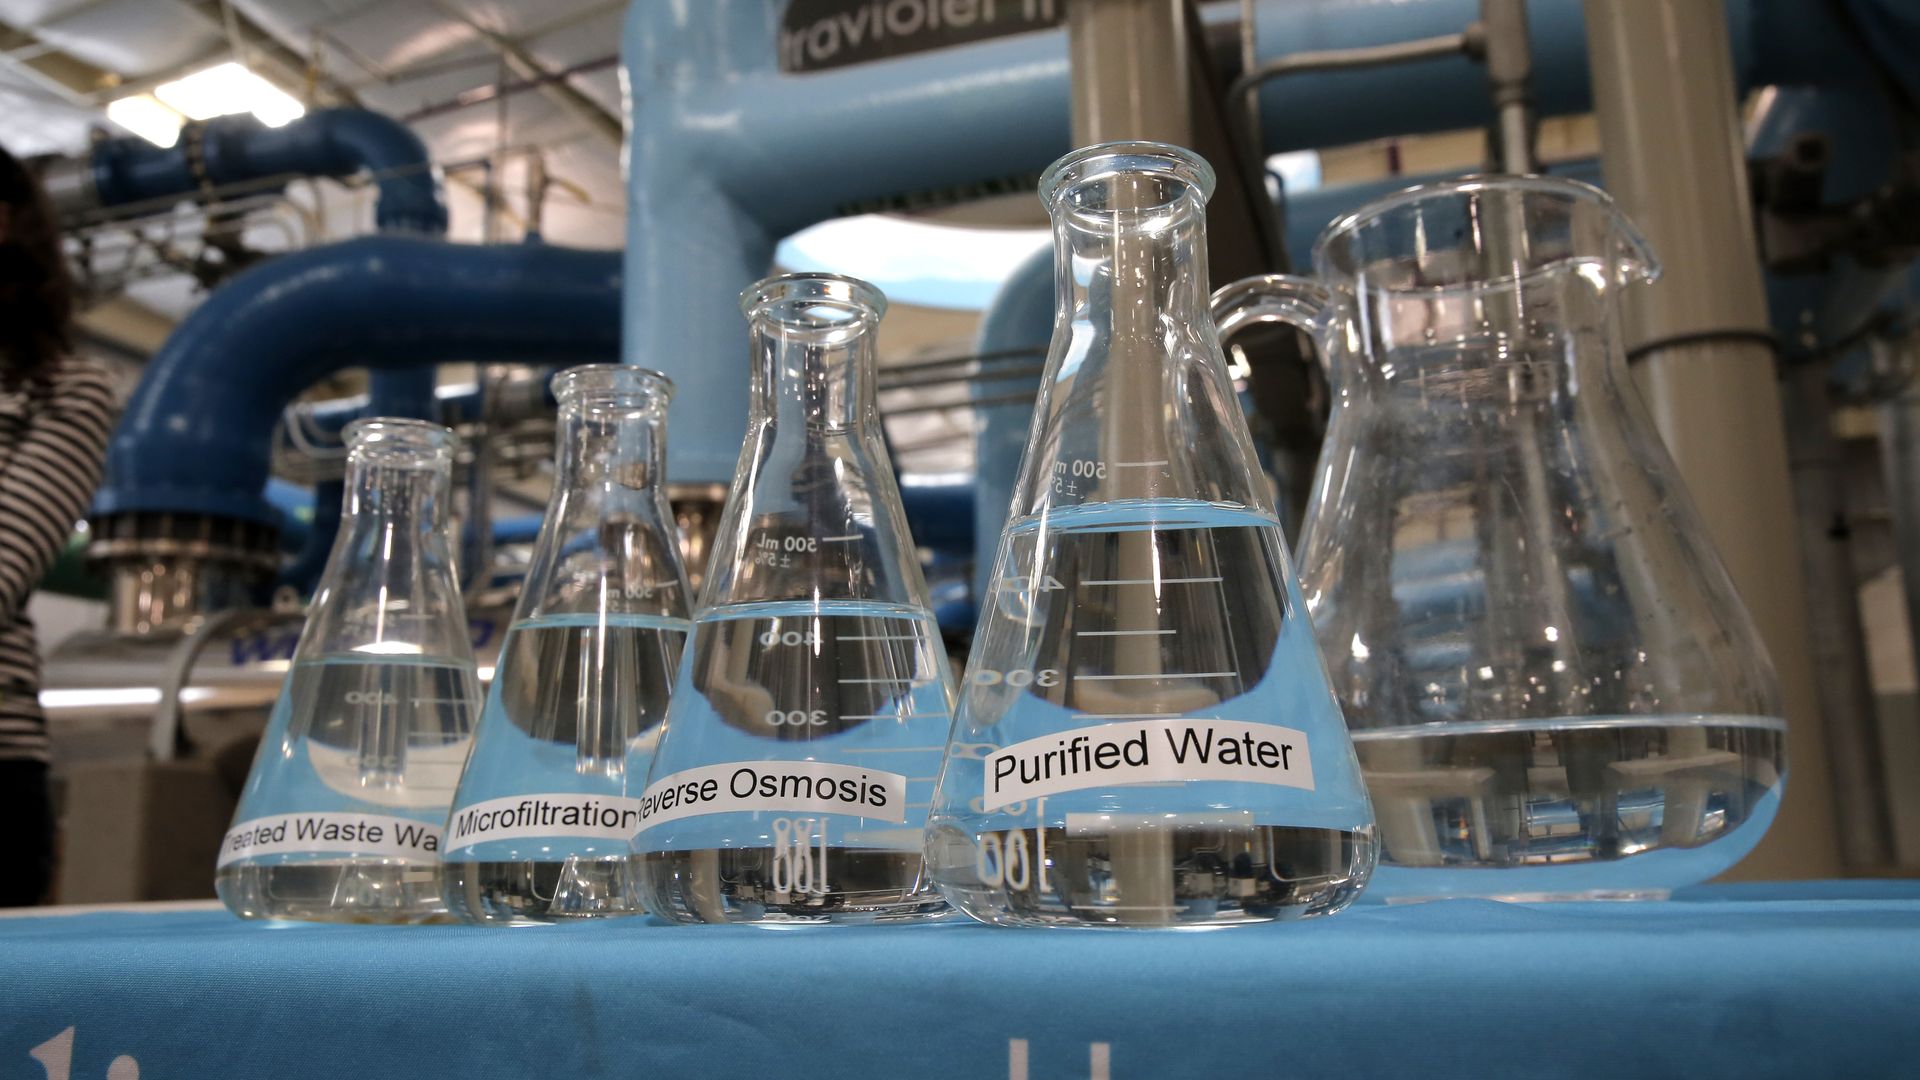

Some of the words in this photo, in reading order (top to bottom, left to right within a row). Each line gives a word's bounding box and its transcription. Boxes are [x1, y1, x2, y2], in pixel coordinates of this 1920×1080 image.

[993, 729, 1150, 793] Purified
[1164, 727, 1292, 771] Water
[729, 767, 887, 807] Osmosis
[296, 818, 384, 843] Waste
[394, 823, 439, 852] Wa
[455, 800, 637, 839] Microfiltration
